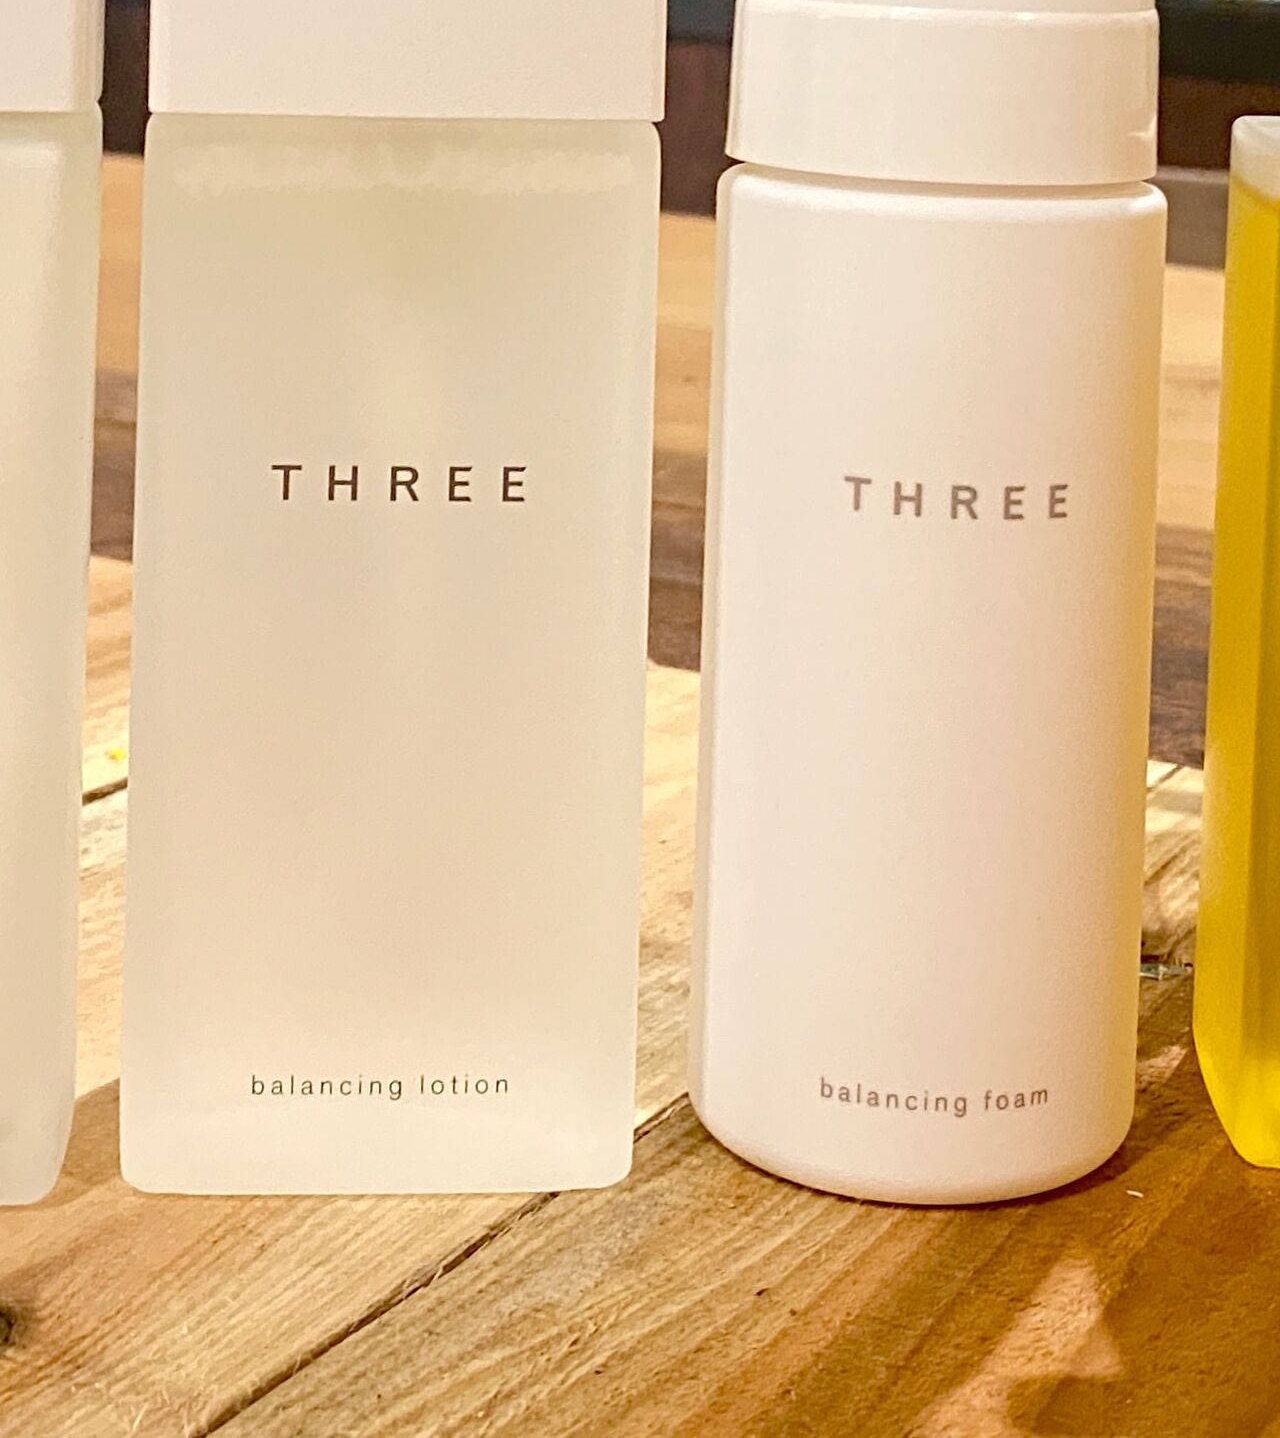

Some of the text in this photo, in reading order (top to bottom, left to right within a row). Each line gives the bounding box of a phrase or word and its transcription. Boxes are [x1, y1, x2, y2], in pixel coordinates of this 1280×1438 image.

[271, 465, 526, 502] THREE
[844, 475, 1069, 521] THREE
[251, 1075, 508, 1101] balancing lotion
[820, 1076, 1050, 1118] balancing foam
